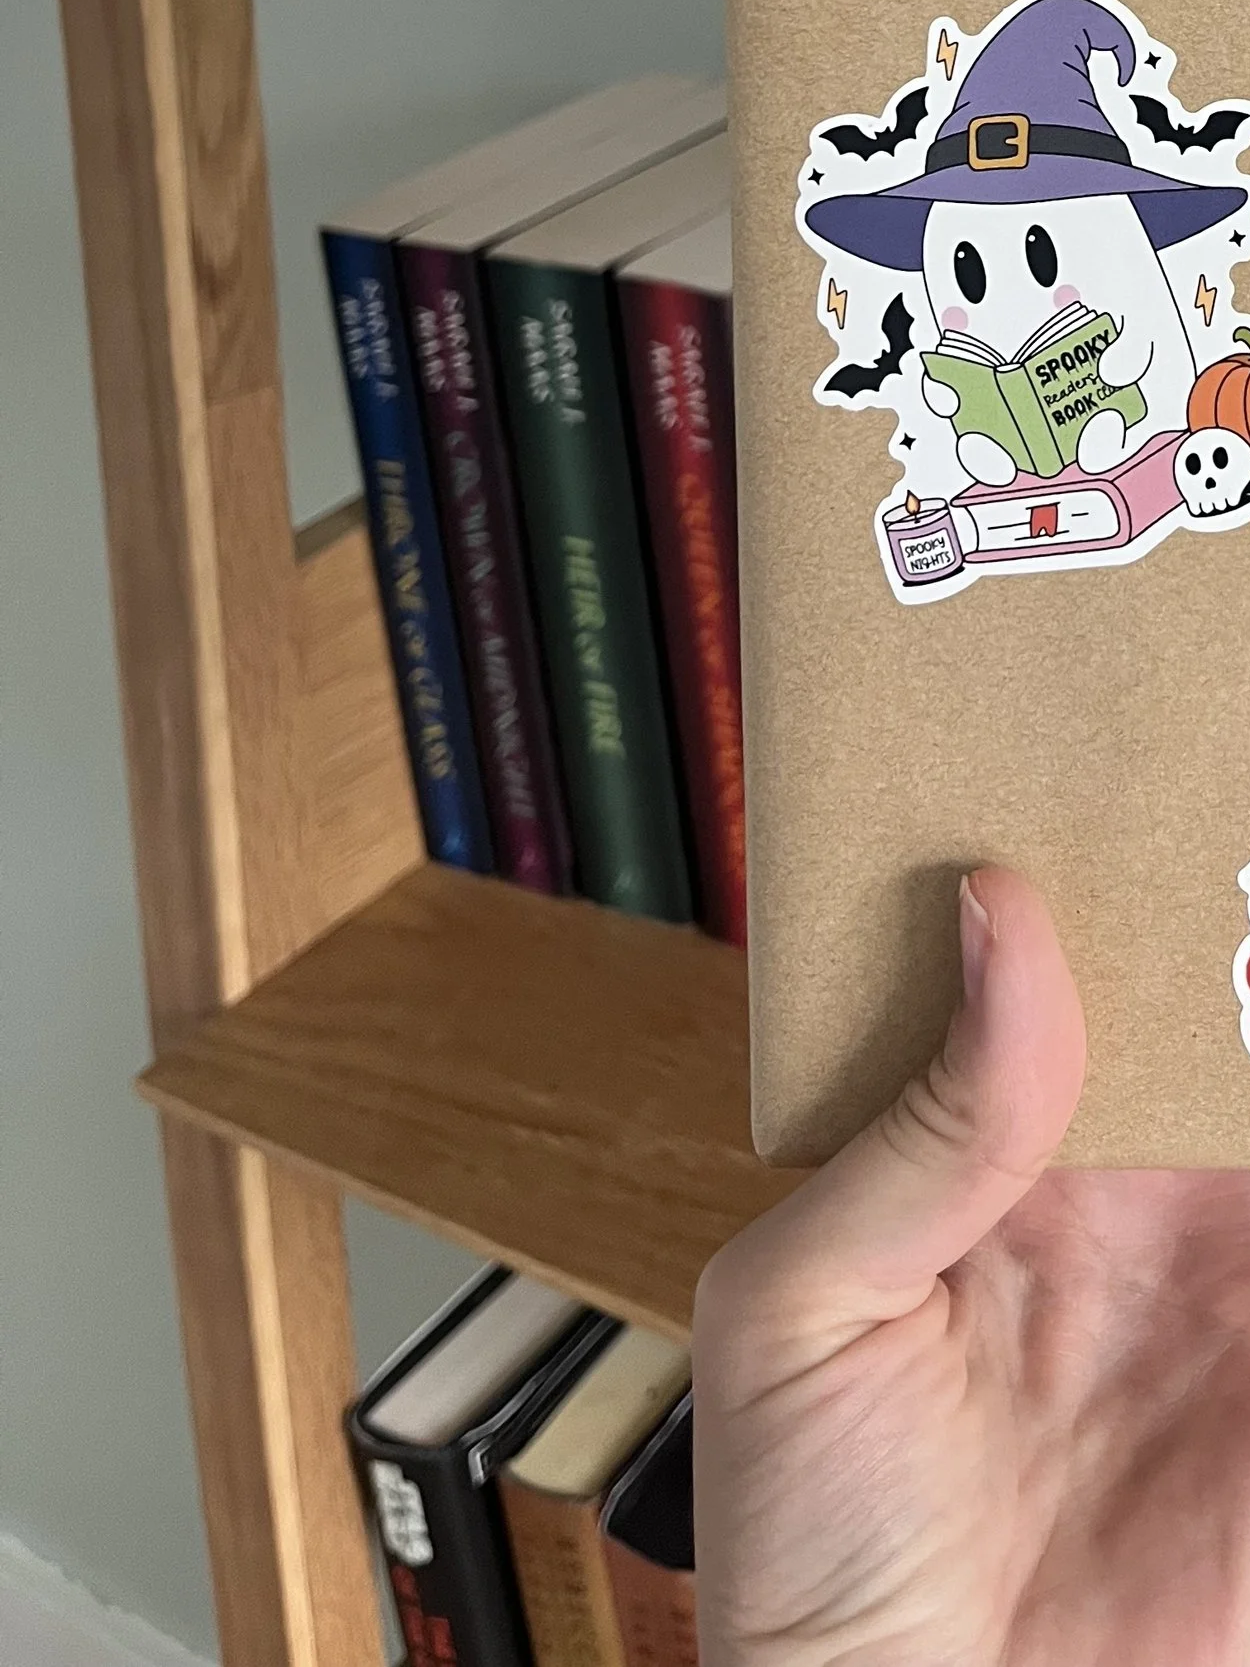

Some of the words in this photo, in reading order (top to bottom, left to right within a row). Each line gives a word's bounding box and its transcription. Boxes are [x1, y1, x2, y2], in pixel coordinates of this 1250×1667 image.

[1035, 329, 1110, 388] SPOOKY
[1051, 392, 1100, 427] BOOK
[905, 536, 946, 558] SPOOKY
[910, 550, 952, 572] NIGHTS
